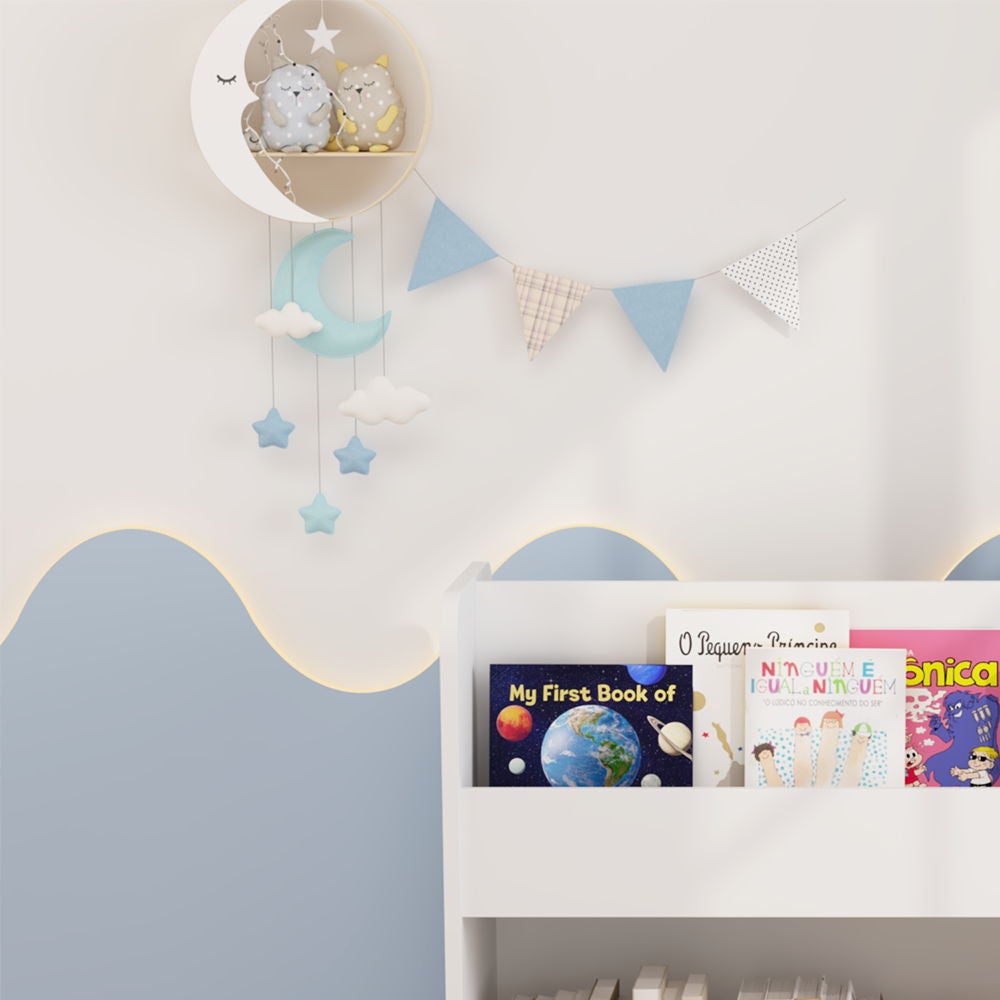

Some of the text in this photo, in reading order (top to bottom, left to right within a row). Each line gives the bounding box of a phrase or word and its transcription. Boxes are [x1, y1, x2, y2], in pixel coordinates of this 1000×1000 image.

[679, 632, 692, 656] O
[905, 658, 999, 687] ônica
[509, 684, 677, 706] My First Book of
